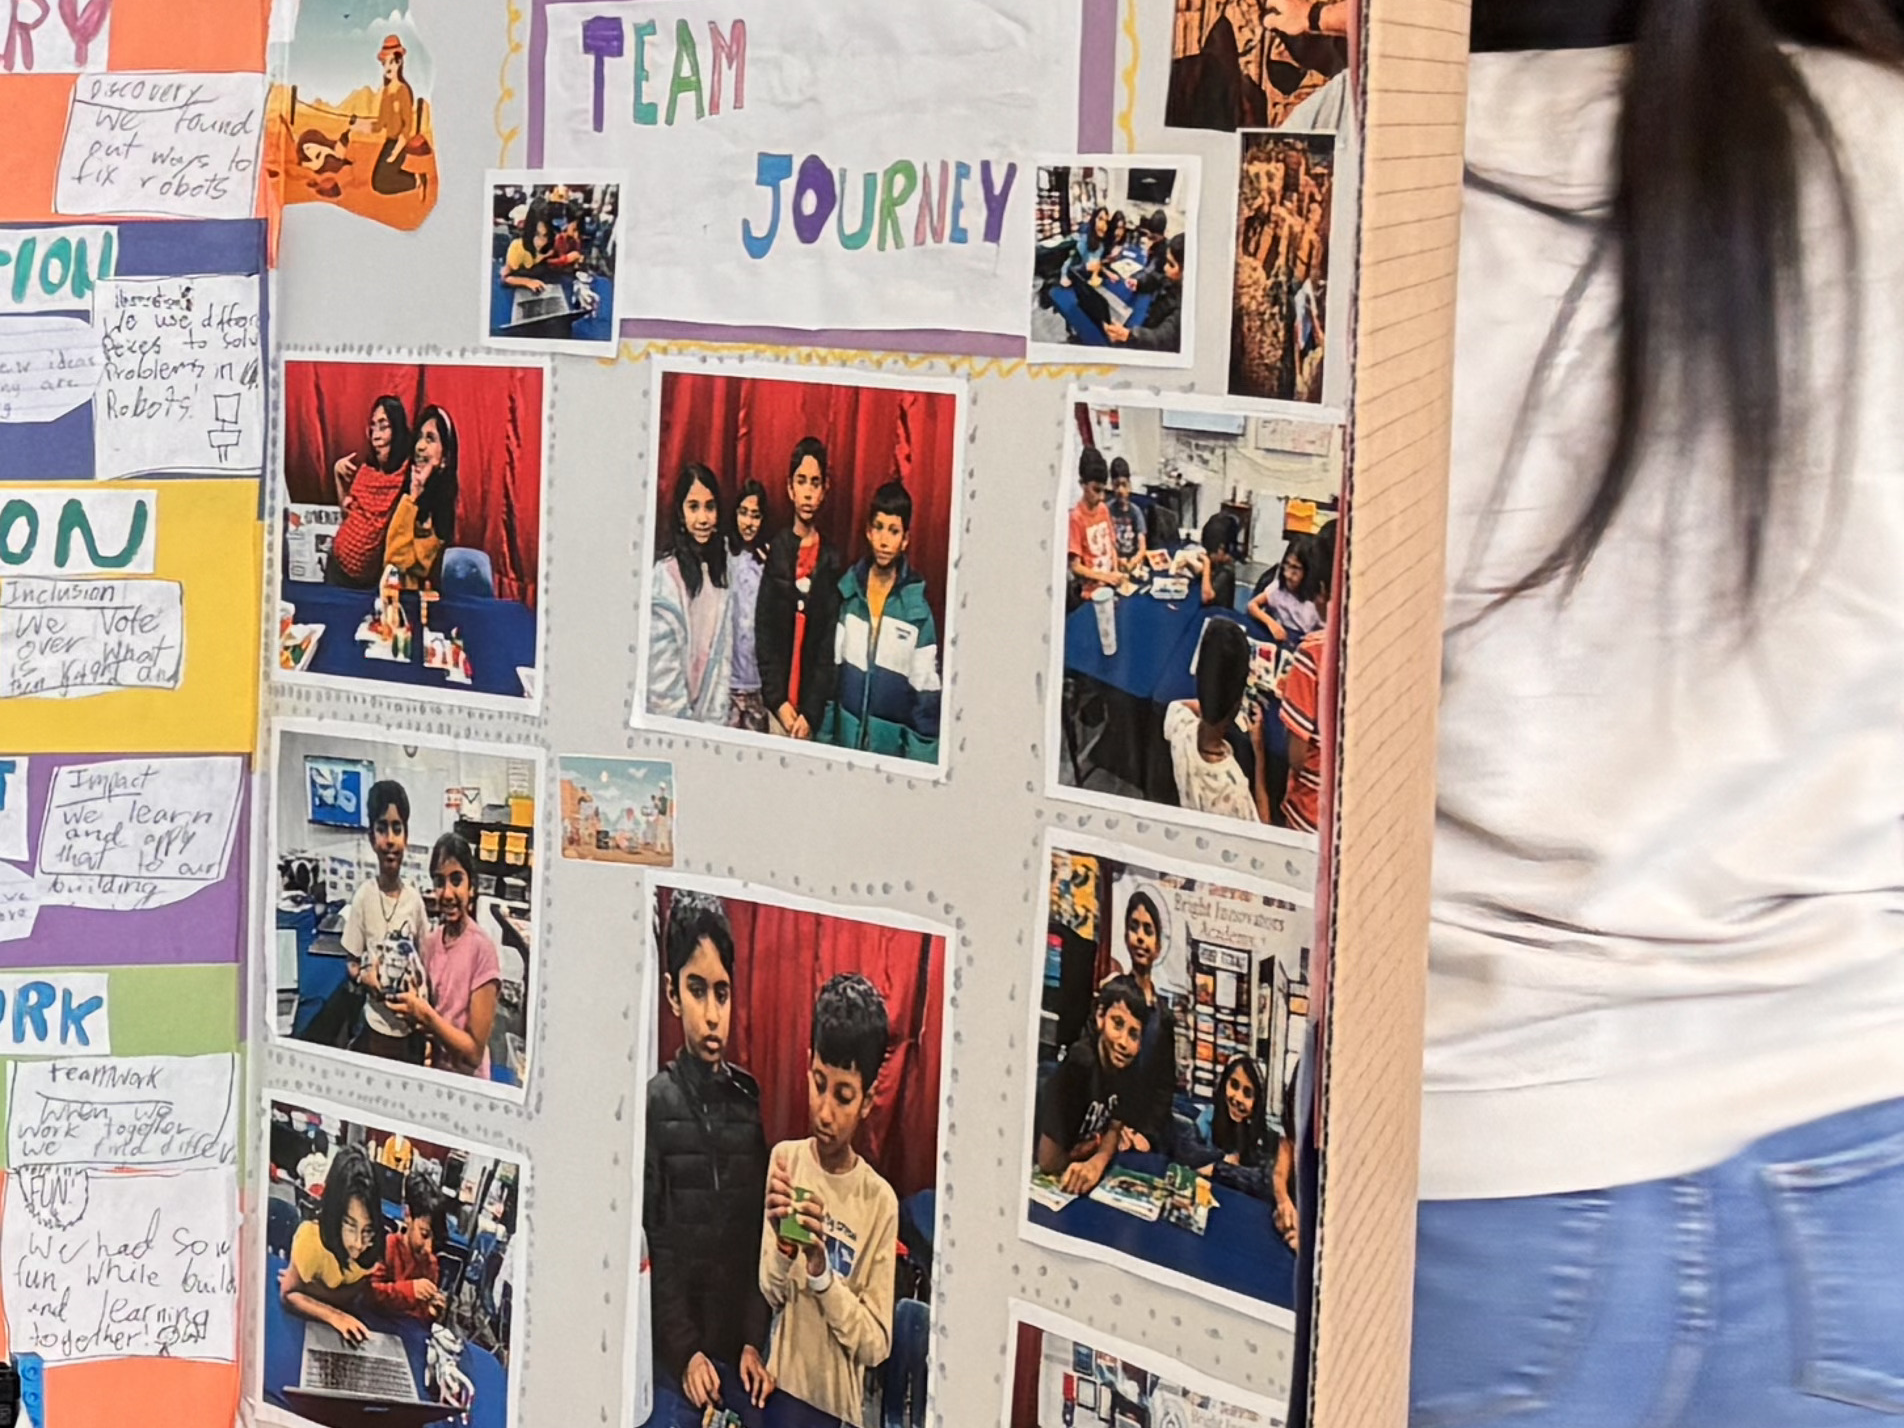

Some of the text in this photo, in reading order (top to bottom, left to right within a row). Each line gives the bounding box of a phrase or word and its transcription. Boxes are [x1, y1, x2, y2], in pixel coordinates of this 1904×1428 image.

[581, 16, 746, 133] TEAM
[229, 146, 251, 172] to
[141, 174, 229, 199] robots
[741, 153, 1017, 261] JOURNEY
[67, 765, 159, 803] Impact
[129, 800, 213, 825] learn
[49, 875, 162, 909] building
[98, 1208, 160, 1259] had
